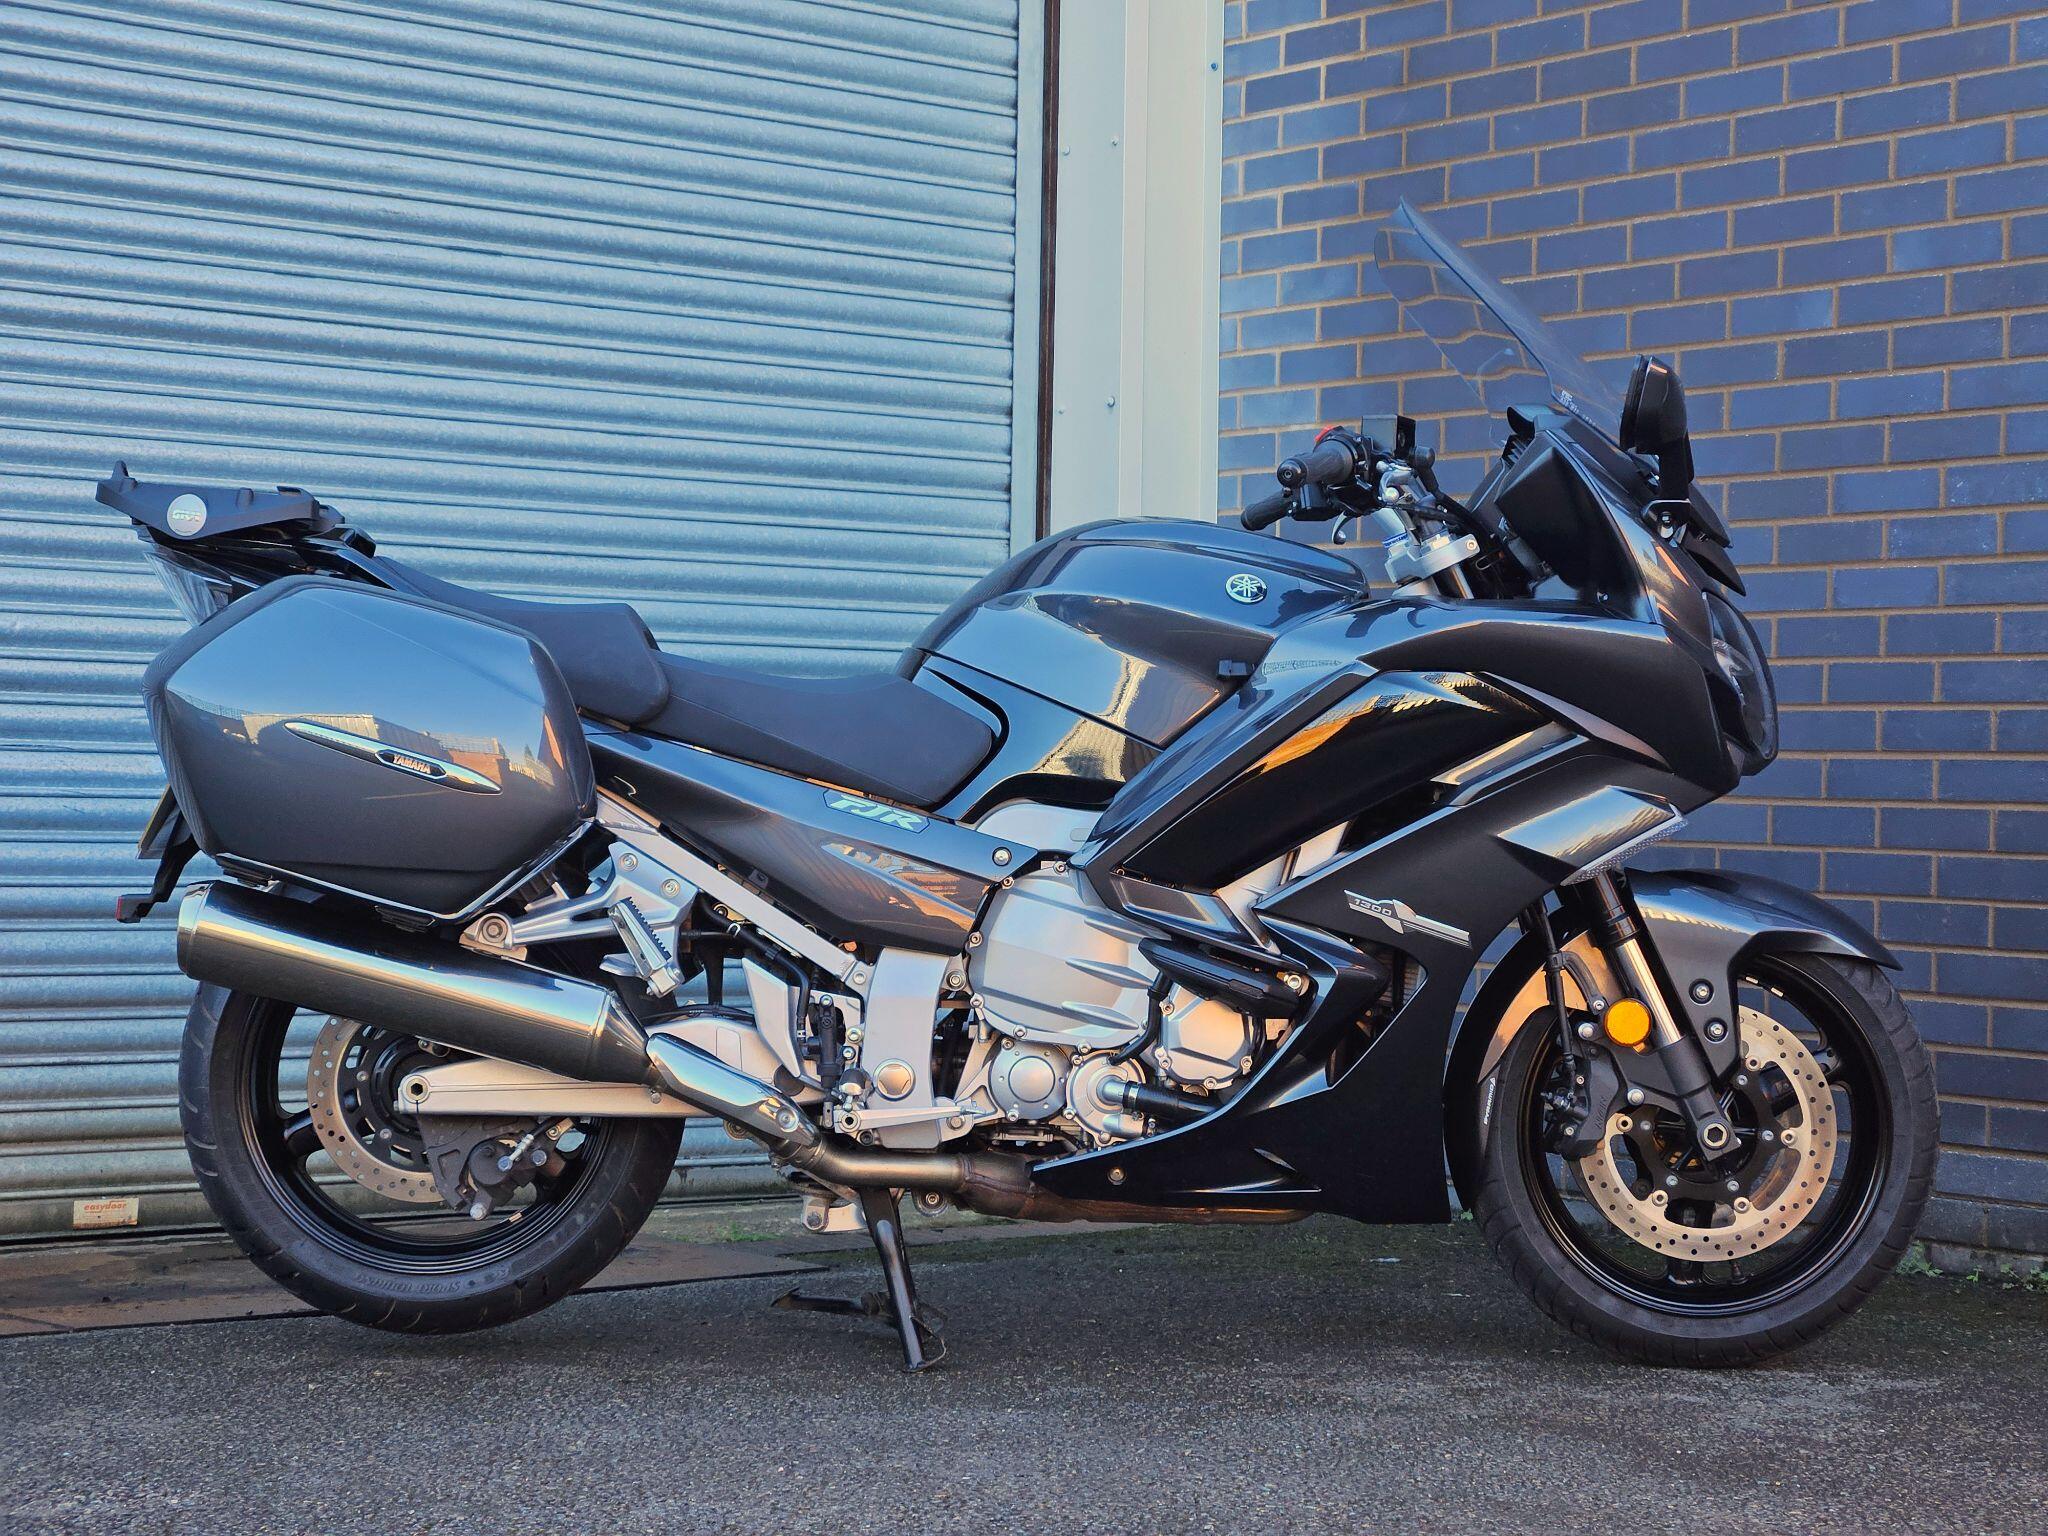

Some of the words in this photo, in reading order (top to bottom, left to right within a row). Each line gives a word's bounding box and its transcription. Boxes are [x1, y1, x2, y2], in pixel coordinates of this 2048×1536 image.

[393, 753, 431, 774] YAMAHA
[830, 794, 922, 830] FJR
[1354, 898, 1392, 916] 1300
[83, 1199, 128, 1213] easydoor
